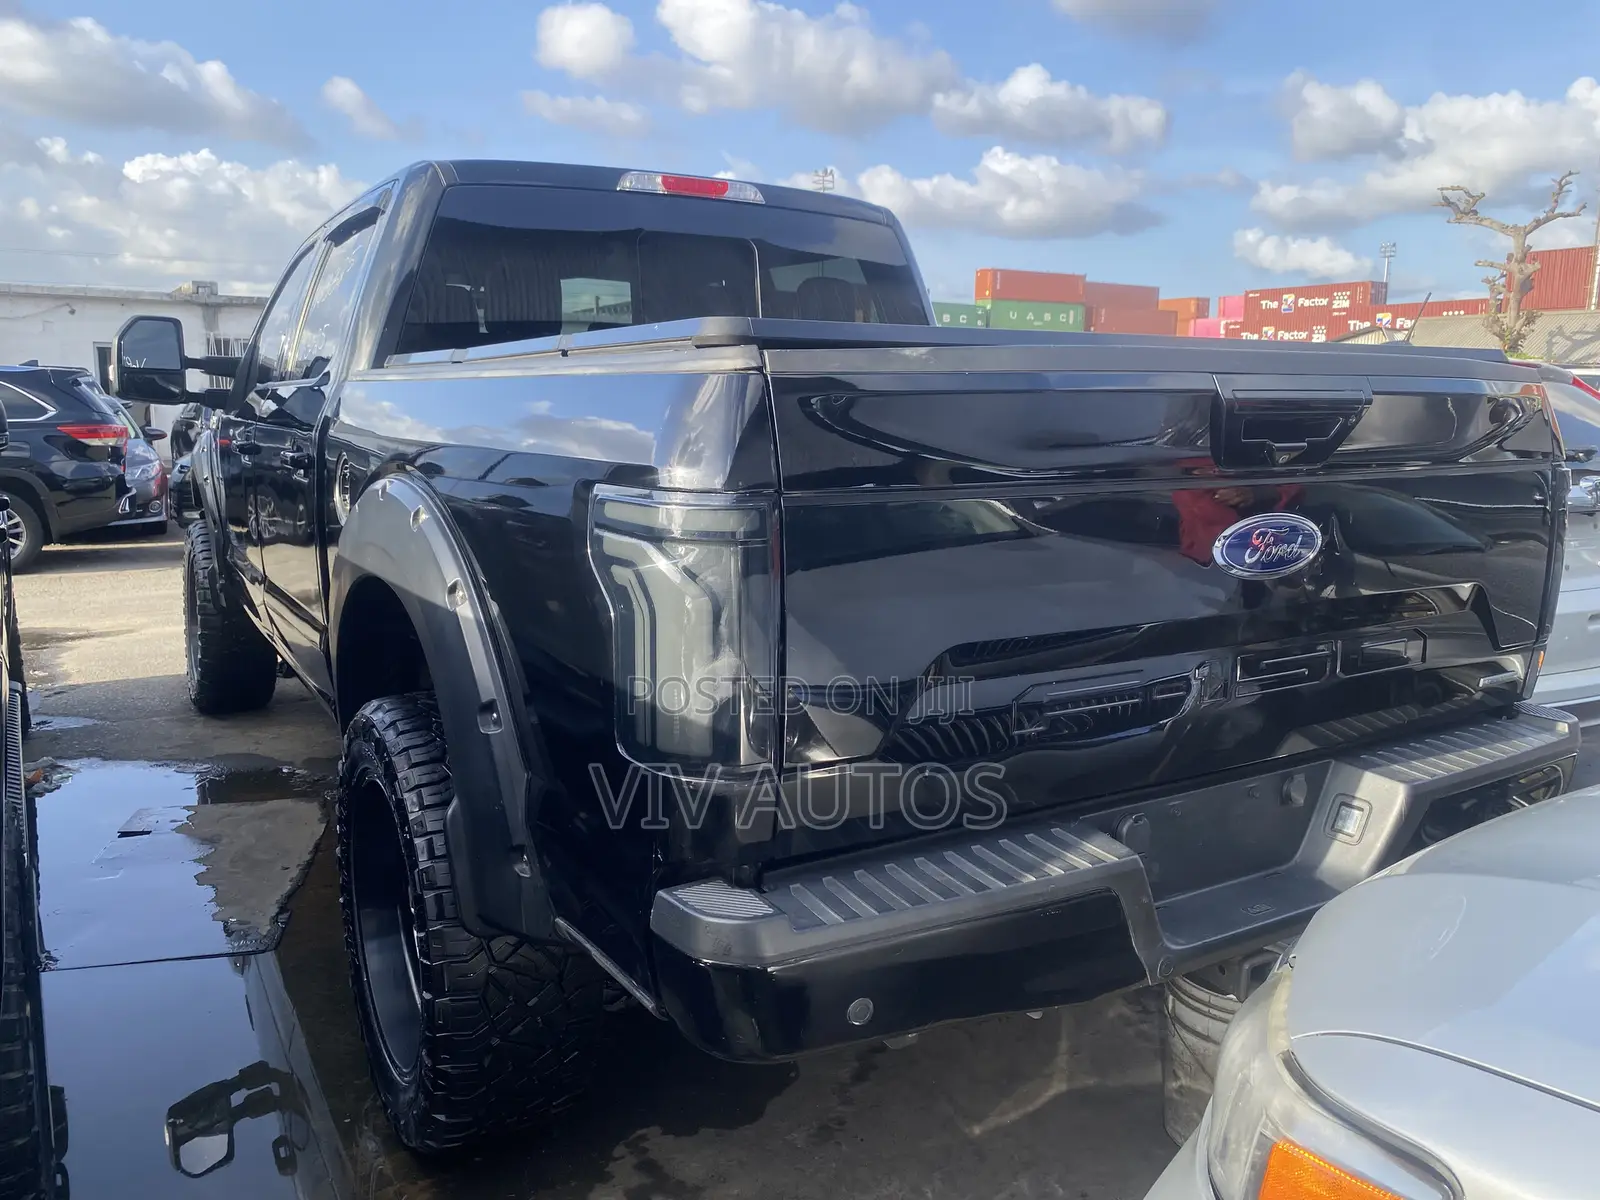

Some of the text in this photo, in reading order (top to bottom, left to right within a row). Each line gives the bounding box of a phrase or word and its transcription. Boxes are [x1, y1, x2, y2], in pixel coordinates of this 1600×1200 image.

[1260, 299, 1279, 310] The
[1297, 297, 1329, 307] Factor
[1347, 320, 1371, 331] The
[1241, 332, 1259, 341] The
[1277, 331, 1309, 341] Factor
[1244, 528, 1302, 564] Ford
